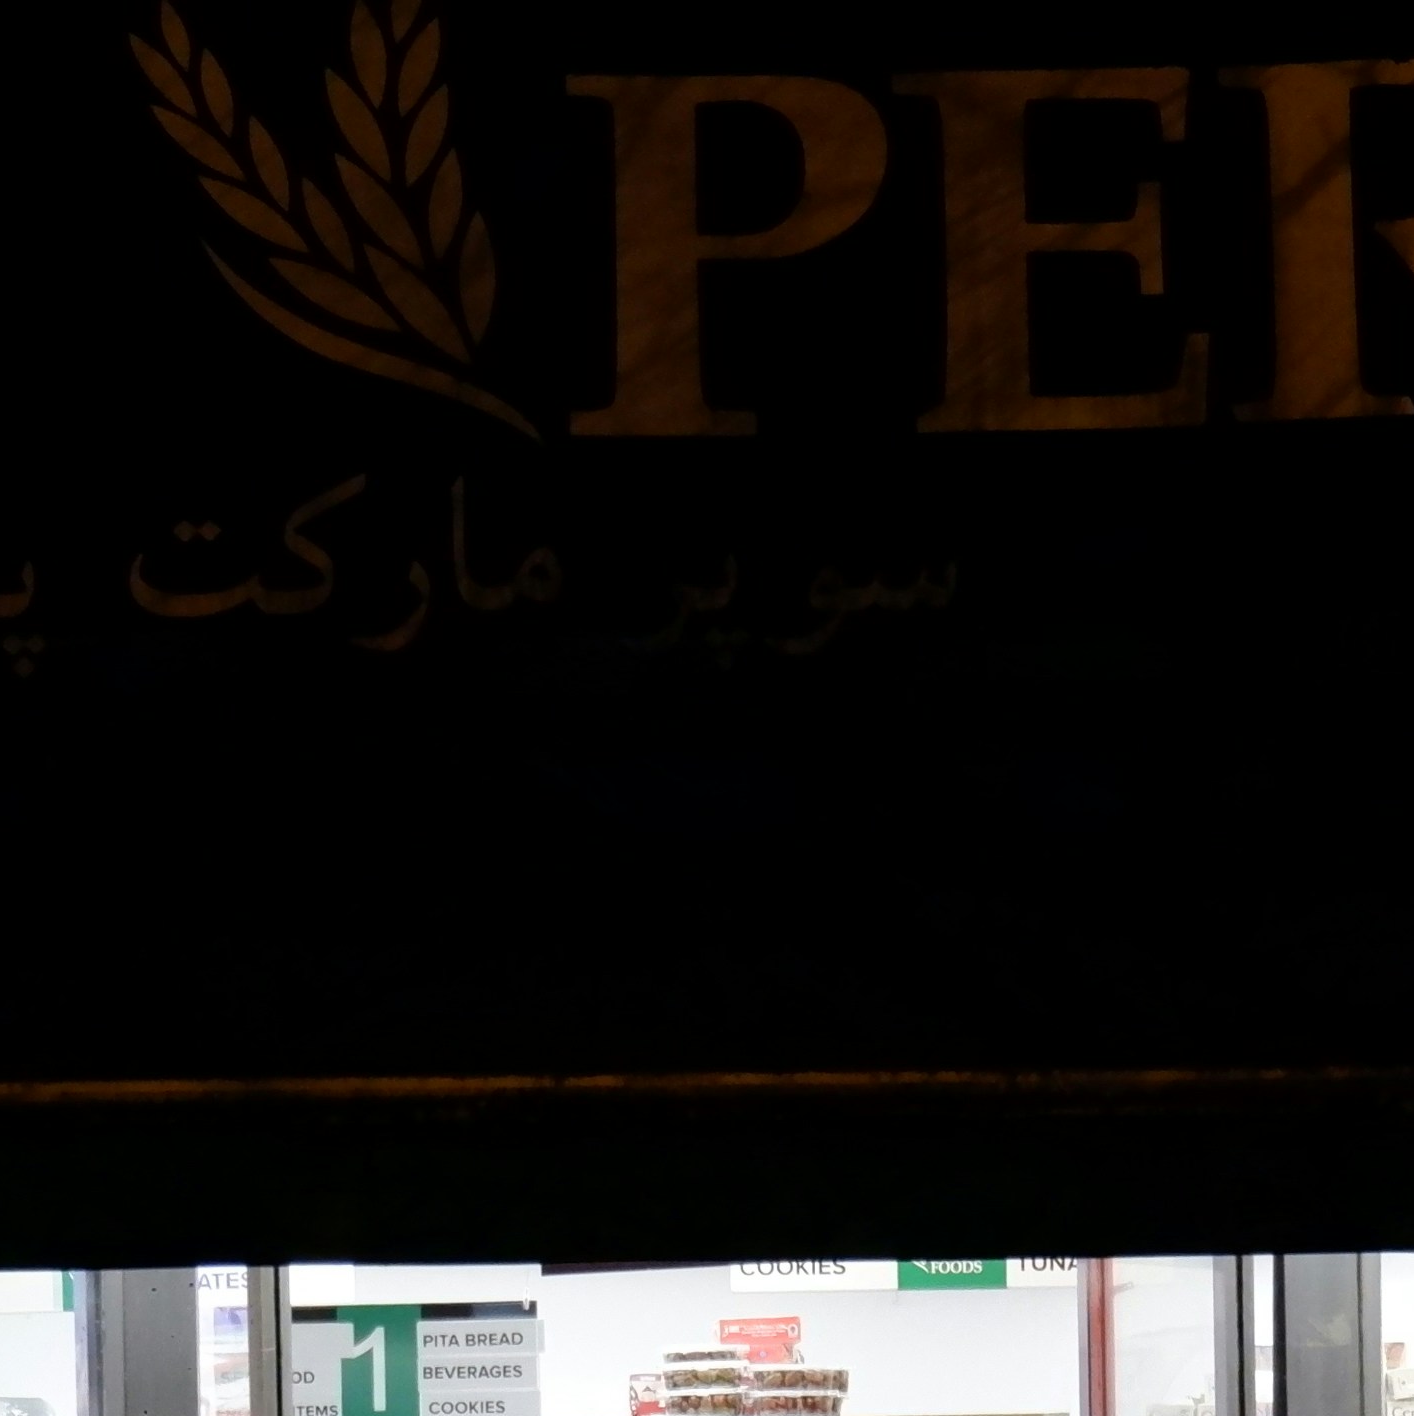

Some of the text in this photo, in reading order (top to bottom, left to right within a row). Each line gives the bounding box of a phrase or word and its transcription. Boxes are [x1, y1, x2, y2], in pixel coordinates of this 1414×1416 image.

[127, 471, 564, 656] مارکت
[930, 1261, 983, 1275] FOODS
[423, 1332, 524, 1348] PITA BREAD
[340, 1326, 386, 1412] 1
[423, 1364, 522, 1380] BEVERAGES
[429, 1400, 505, 1415] COOKIES
